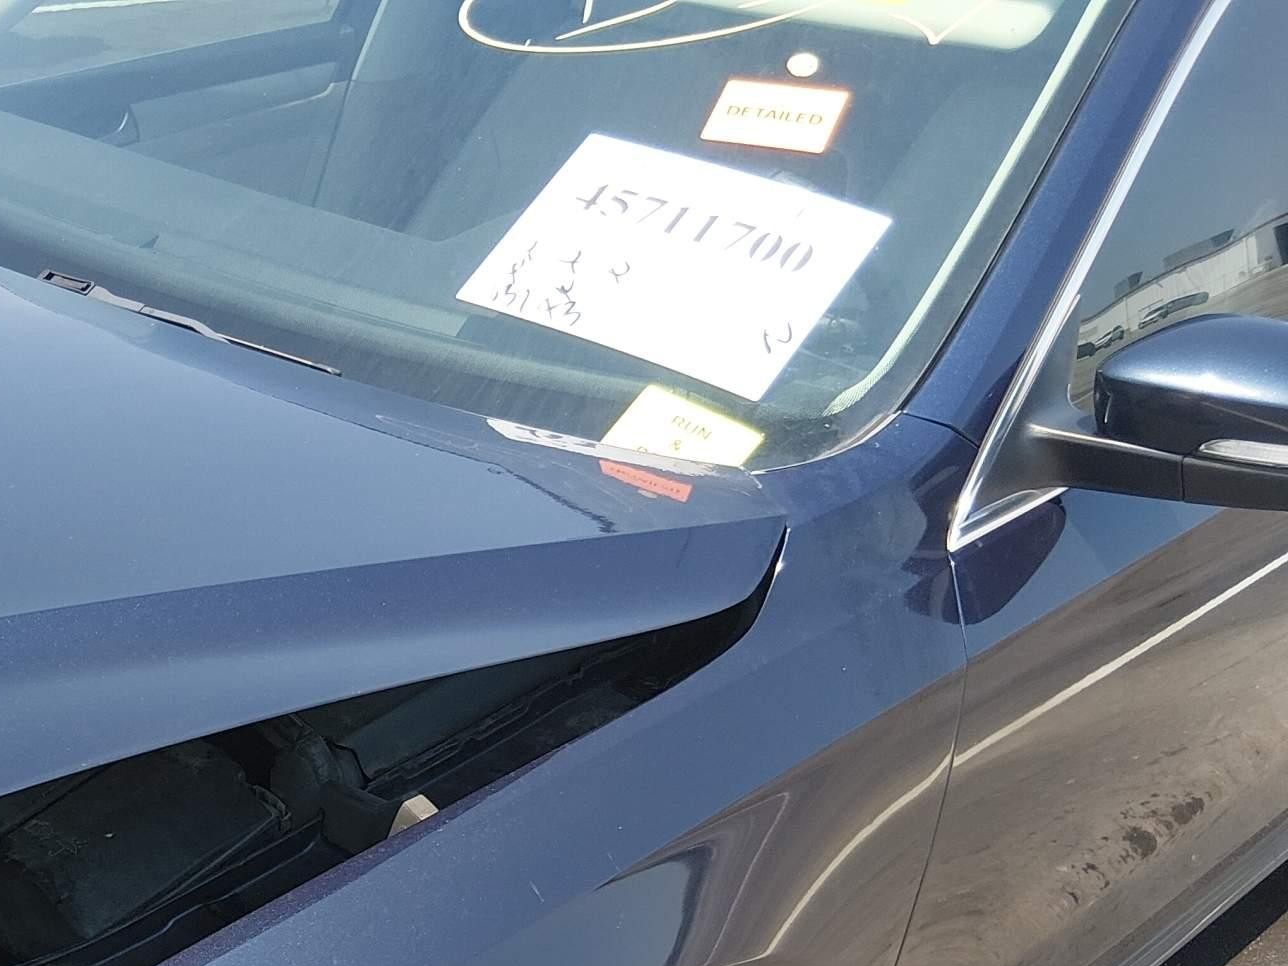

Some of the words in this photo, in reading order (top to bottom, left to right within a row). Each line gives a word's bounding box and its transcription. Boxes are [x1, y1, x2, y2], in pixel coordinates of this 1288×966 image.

[726, 104, 824, 126] DETAILED
[575, 184, 813, 272] 45711700
[671, 415, 713, 441] RUN
